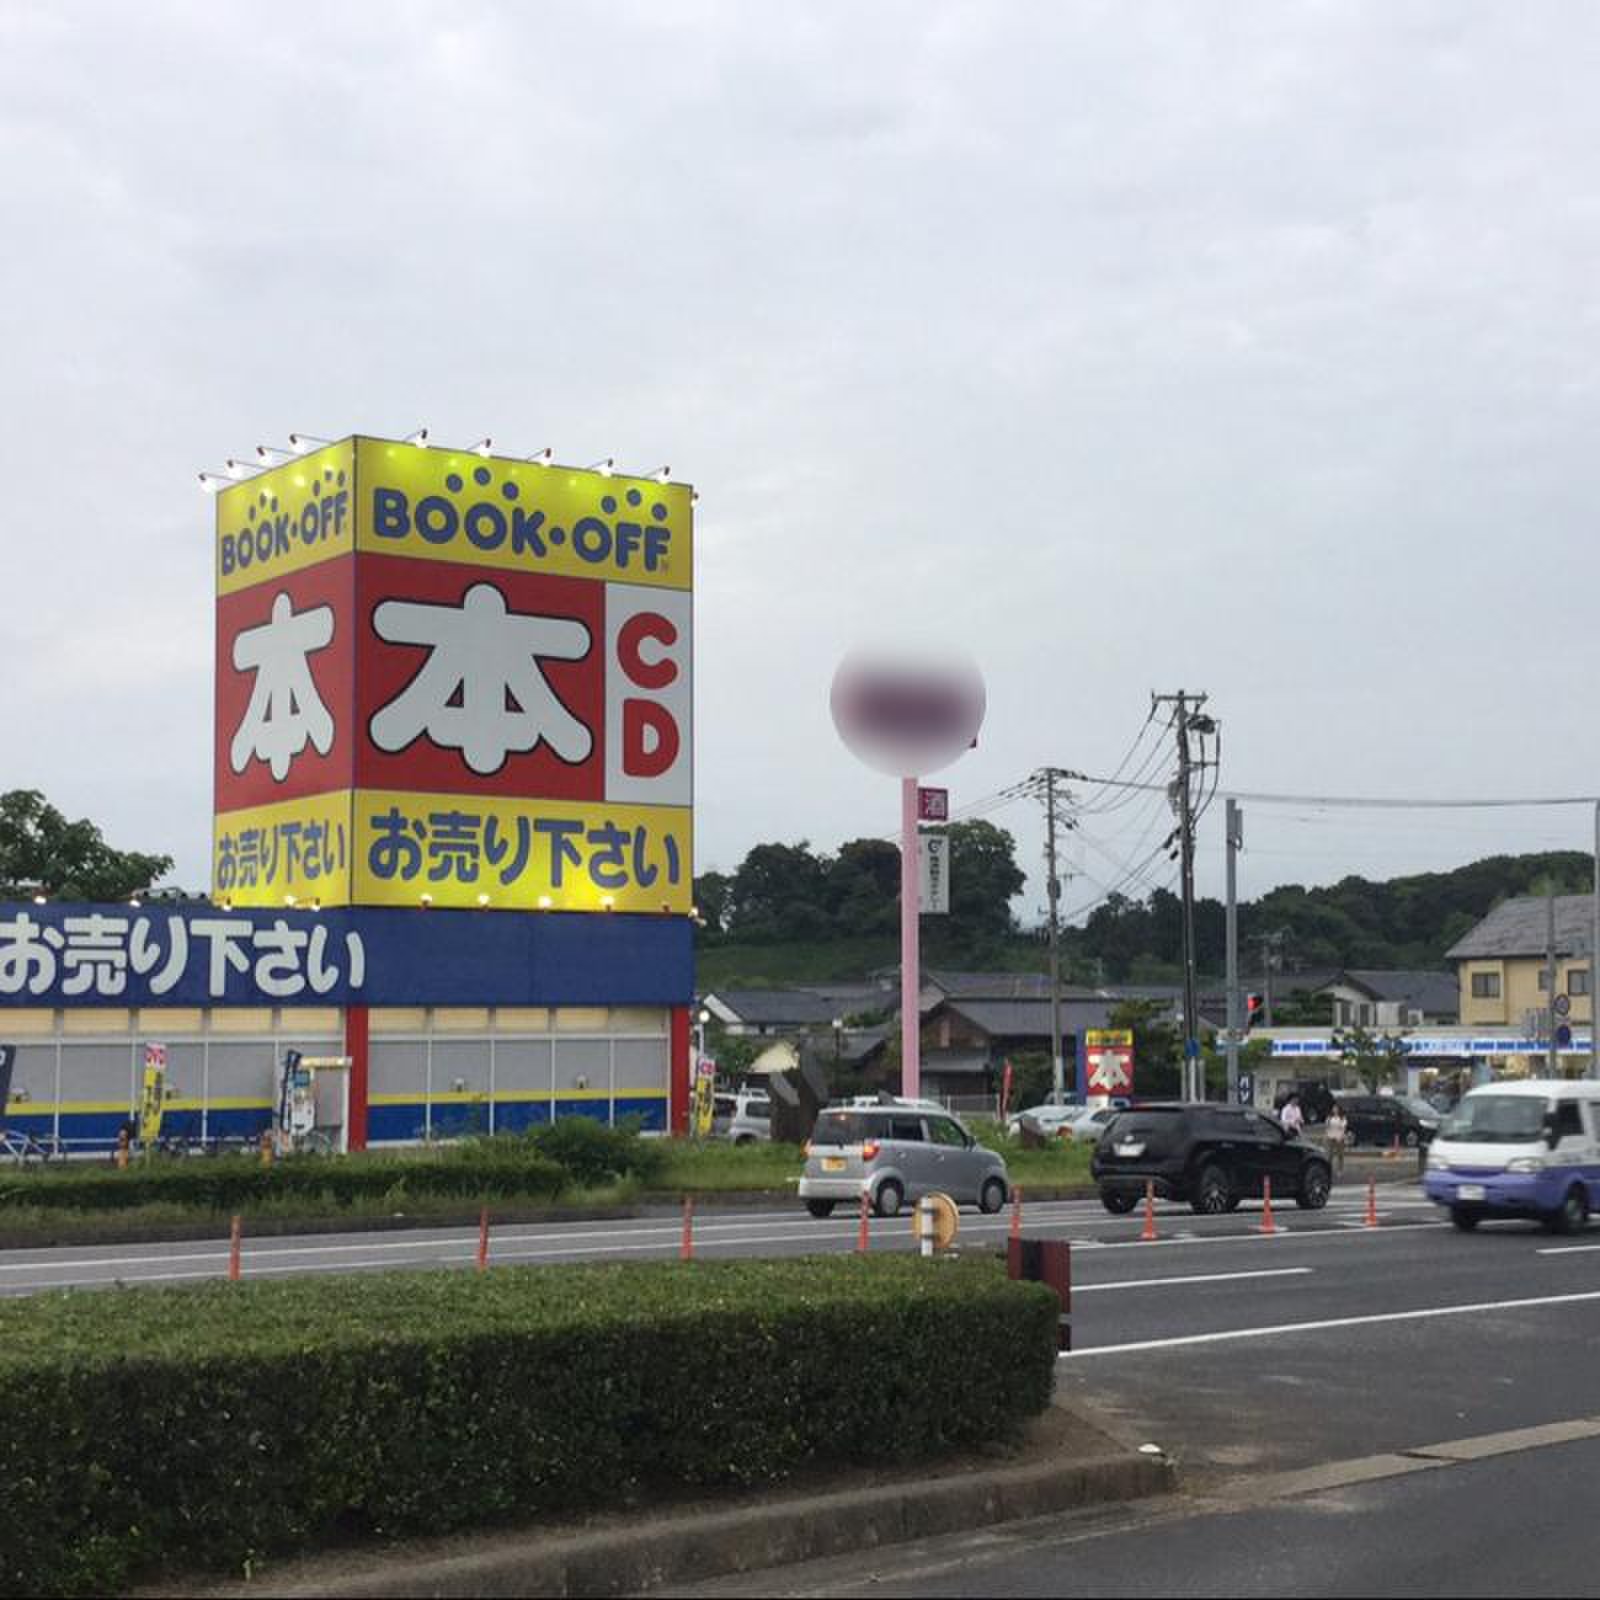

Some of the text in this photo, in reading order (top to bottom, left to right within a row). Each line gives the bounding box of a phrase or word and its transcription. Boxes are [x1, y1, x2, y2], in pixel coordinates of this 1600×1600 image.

[230, 590, 336, 782] 本
[368, 581, 594, 777] 本
[217, 818, 345, 889] お売り下さい
[368, 808, 680, 888] お売り下さい
[0, 912, 366, 997] お売り下さい
